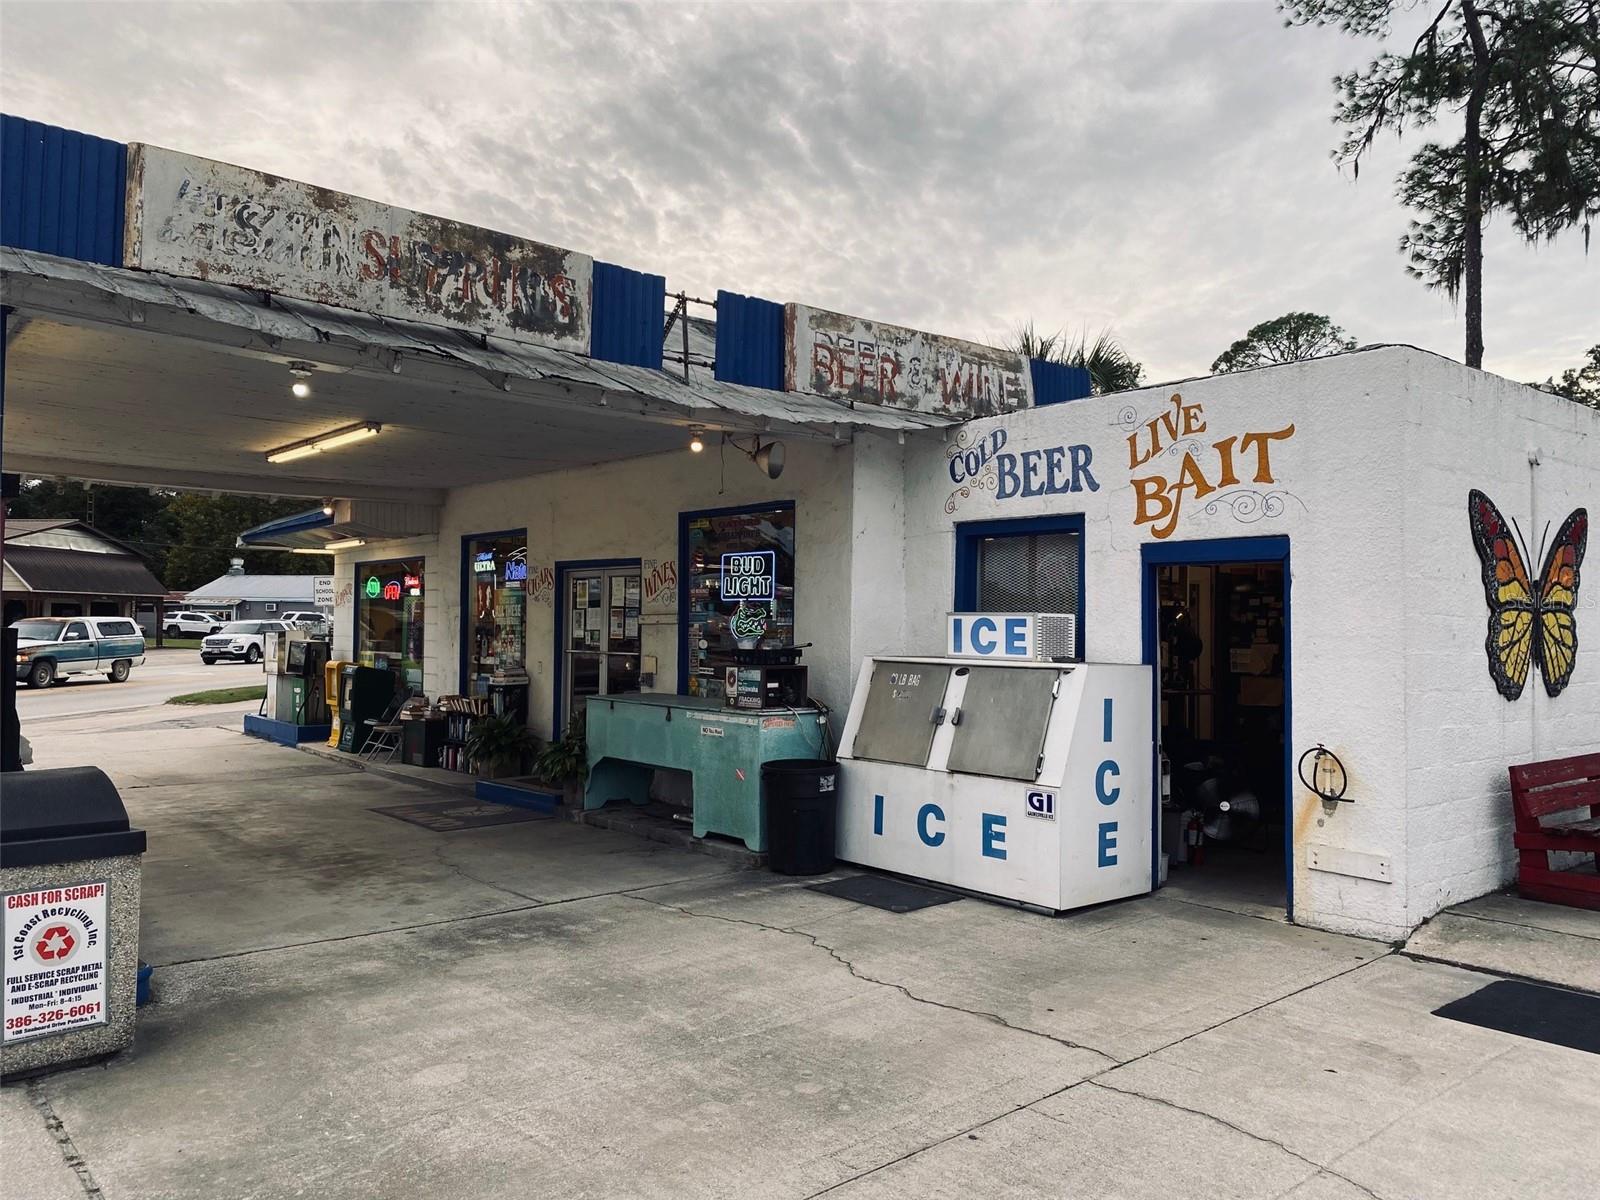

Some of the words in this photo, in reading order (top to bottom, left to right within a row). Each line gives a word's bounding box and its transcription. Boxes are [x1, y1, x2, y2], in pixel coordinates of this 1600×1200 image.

[813, 340, 898, 400] BEER
[1126, 393, 1207, 469] LIVE
[950, 427, 1008, 483] COLD
[995, 444, 1101, 500] BEER
[1129, 422, 1295, 538] BAIT
[730, 556, 765, 576] BUD
[527, 568, 554, 596] CIGARS
[644, 561, 677, 598] WINES
[724, 575, 772, 596] LIGHT
[953, 617, 1027, 656] ICE
[907, 673, 921, 687] BAG
[1095, 698, 1120, 868] ICE
[1028, 792, 1052, 814] GI
[874, 795, 1007, 860] ICE
[8, 893, 39, 909] CASH
[41, 890, 62, 905] FOR
[65, 884, 105, 901] SCRAP!
[15, 914, 42, 944] Coast
[86, 928, 99, 949] Inc.
[13, 944, 24, 961] 1st
[6, 977, 23, 986] FULL
[24, 971, 55, 983] SERVICE
[56, 967, 80, 979] SCRAP
[81, 962, 103, 974] METAL
[10, 984, 26, 993] AND
[28, 978, 59, 991] E-SCRAP
[60, 971, 99, 985] RECYCLING
[11, 991, 54, 1005] INDUSTRIAL
[59, 983, 98, 997] INDIVIDUAL
[28, 999, 59, 1011] Mon-Fri:
[60, 995, 82, 1005] 8-4:15
[6, 1001, 101, 1029] 386-326-6061
